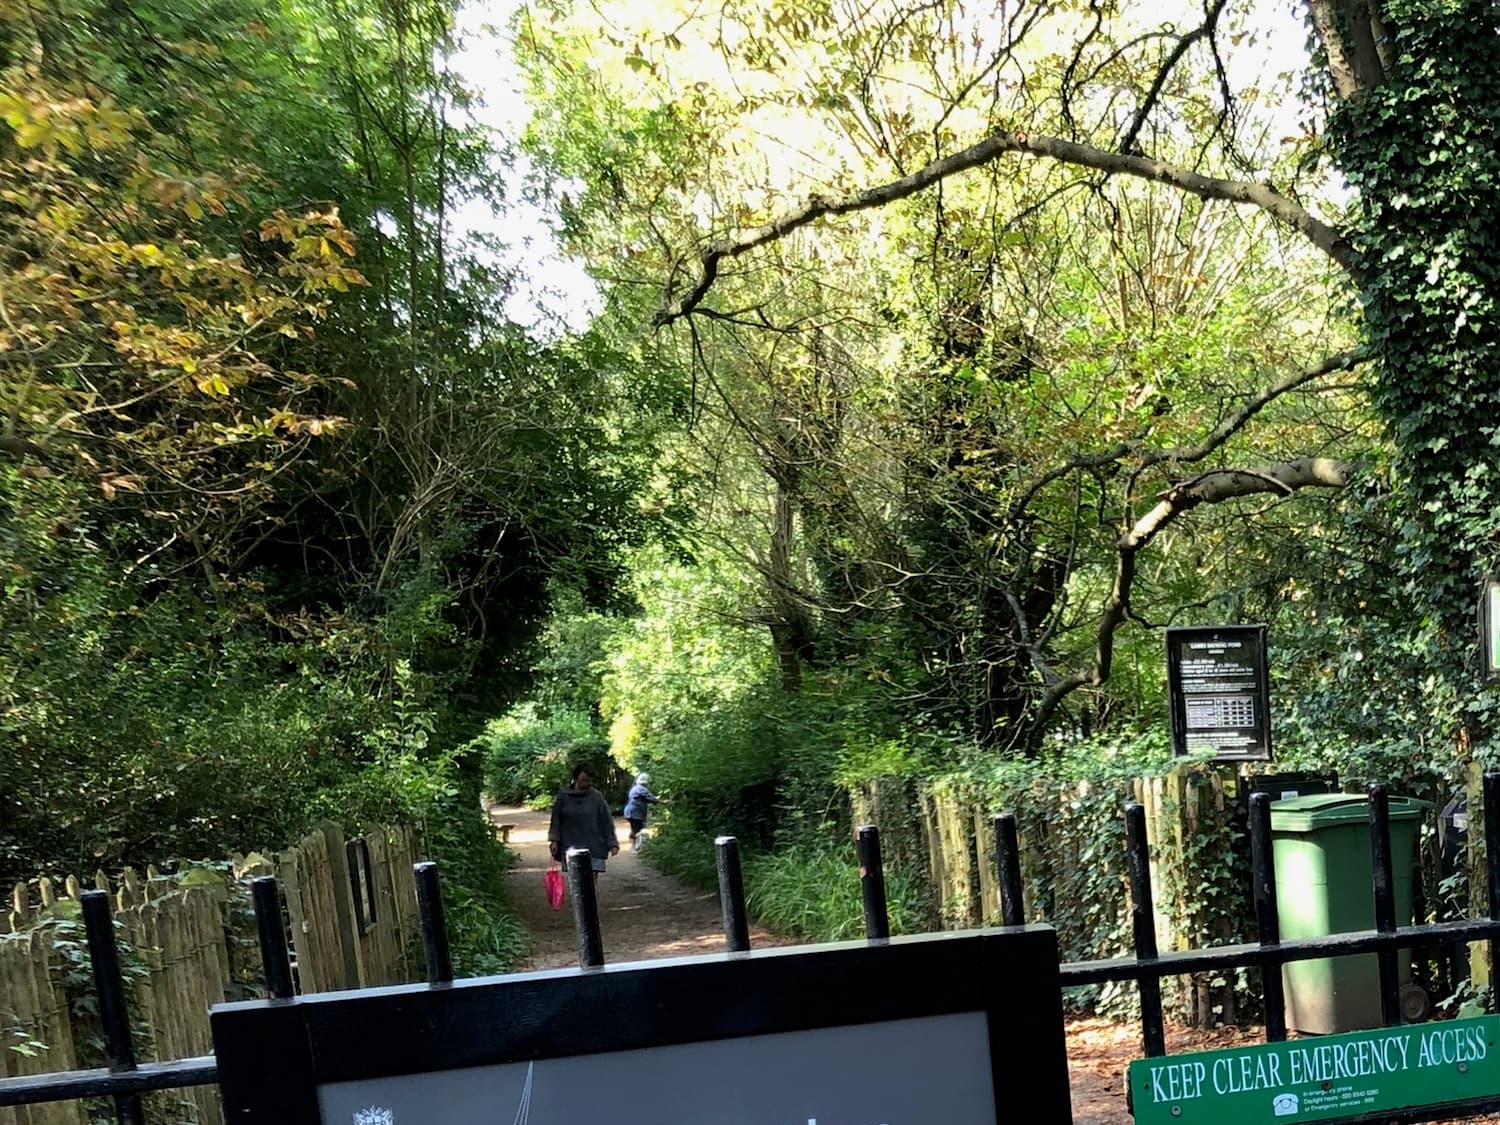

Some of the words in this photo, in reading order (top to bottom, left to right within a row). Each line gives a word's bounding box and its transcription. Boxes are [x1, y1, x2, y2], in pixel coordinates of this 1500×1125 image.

[1151, 1062, 1206, 1103] KEEP
[1212, 1052, 1283, 1094] CLEAR
[1288, 1034, 1411, 1085] EMERGENCY
[1418, 1026, 1486, 1067] ACCESS
